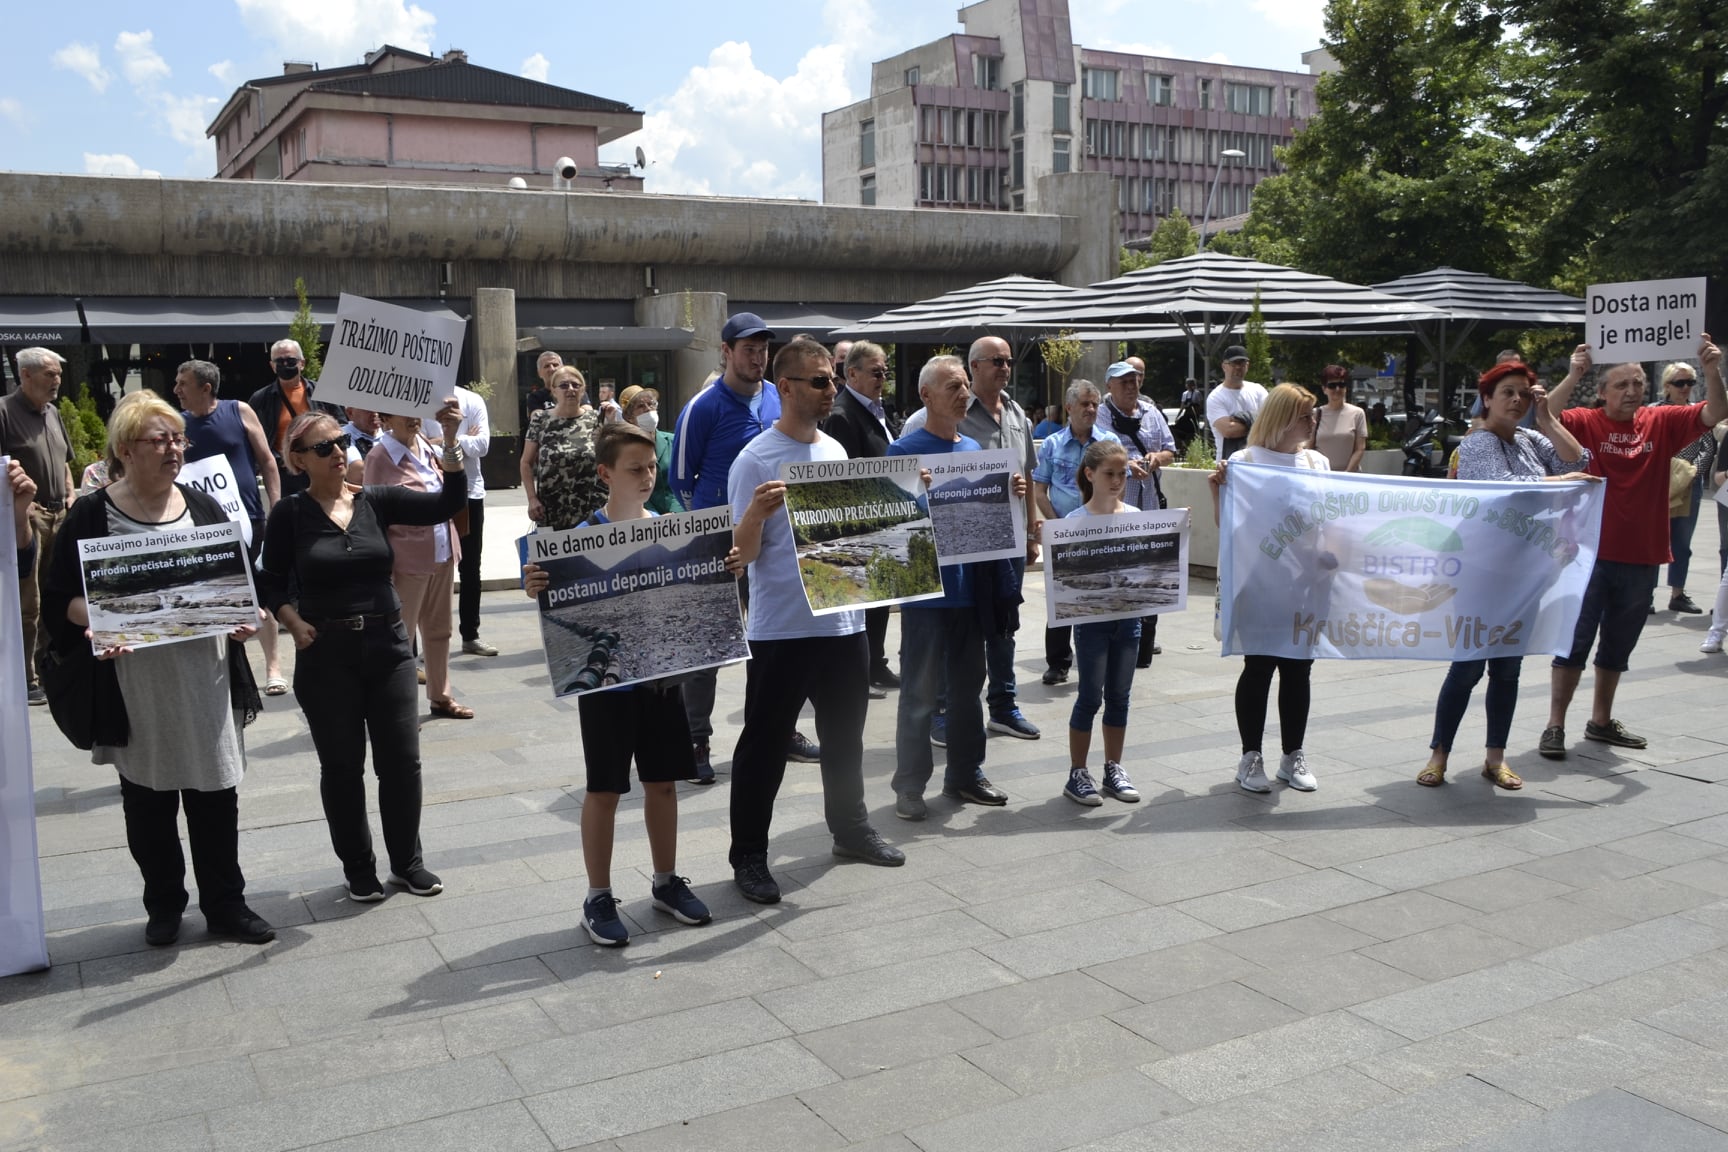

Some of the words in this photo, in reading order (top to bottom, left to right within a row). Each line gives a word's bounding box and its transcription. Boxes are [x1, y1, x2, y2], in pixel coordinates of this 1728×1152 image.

[1592, 294, 1650, 315] Dosta
[1656, 292, 1697, 310] nam
[340, 317, 398, 356] TRAŽIMO
[401, 329, 453, 367] POŠTENO
[1599, 325, 1617, 350] je
[1625, 319, 1690, 346] magle!
[348, 366, 433, 408] ODLUČIVANJE
[789, 465, 814, 480] SVE
[817, 463, 844, 478] OVO
[848, 459, 904, 476] POTOPITI
[934, 466, 945, 474] da
[947, 463, 978, 474] Janjićki
[979, 461, 1008, 472] slapovi
[185, 473, 227, 493] MO
[934, 489, 972, 501] deponija
[973, 485, 1002, 497] otpada
[793, 508, 843, 526] PRIRODNO
[845, 500, 918, 521] PREČIŠĆAVANJE
[1260, 491, 1369, 561] EKOLOŠKO
[1378, 489, 1480, 519] DRUŠTVO
[84, 538, 142, 553] Sačuvajmo
[145, 533, 188, 547] Janjićke
[191, 528, 233, 541] slapove
[536, 540, 558, 558] Ne
[562, 534, 605, 554] damo
[609, 528, 626, 546] da
[631, 518, 680, 544] Janjićki
[685, 510, 730, 535] slapovi
[1053, 527, 1102, 539] Sačuvajmo
[1105, 522, 1140, 536] Janjićke
[1142, 520, 1177, 531] slapove
[1057, 547, 1089, 560] prirodni
[1090, 544, 1126, 556] prečistač
[1127, 543, 1149, 552] rijeke
[1150, 541, 1174, 549] Bosne
[90, 563, 129, 579] prirodni
[131, 557, 174, 575] prečistač
[176, 555, 203, 568] rijeke
[205, 551, 235, 562] Bosne
[1363, 555, 1462, 577] BISTRO
[548, 580, 608, 607] postanu
[611, 565, 673, 592] deponija
[677, 556, 725, 580] otpada
